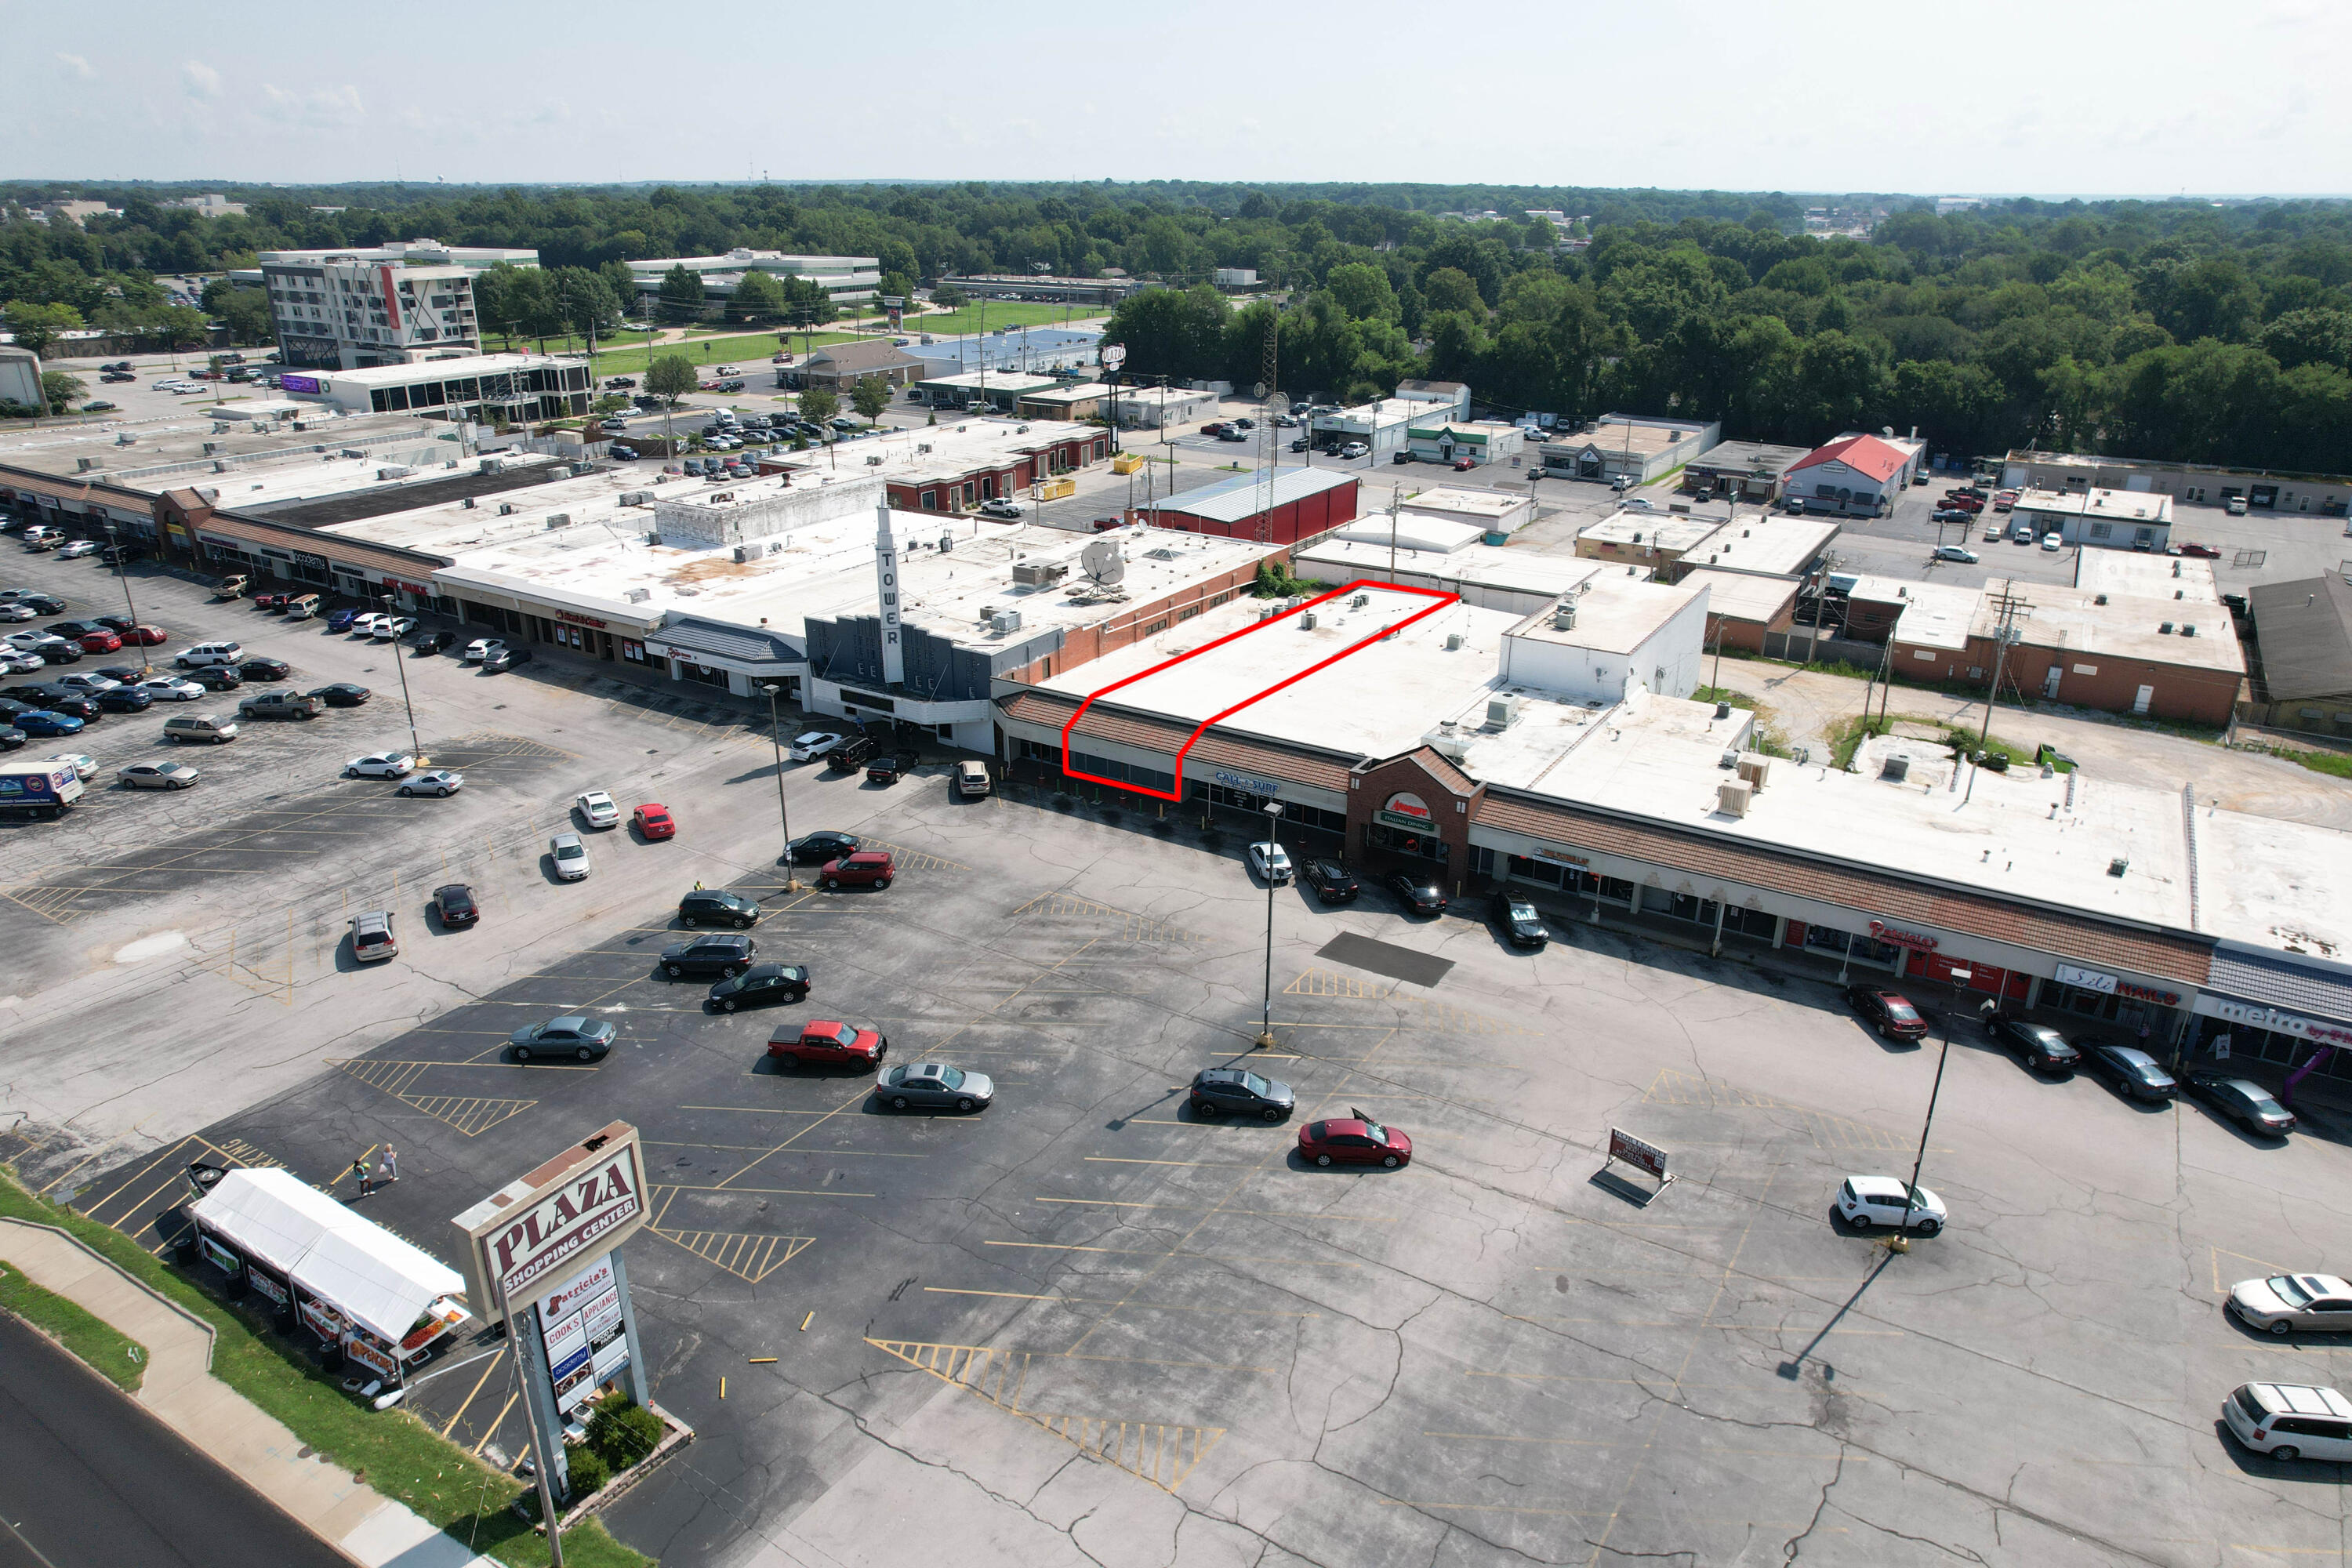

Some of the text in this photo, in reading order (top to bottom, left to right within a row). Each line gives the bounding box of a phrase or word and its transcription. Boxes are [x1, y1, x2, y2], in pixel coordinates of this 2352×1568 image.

[882, 553, 898, 644] TOWER
[1216, 771, 1241, 786] CALL
[1254, 779, 1280, 793] SURF
[1385, 815, 1429, 829] ITALIAN DINING
[1869, 920, 1939, 949] Patricia's
[2118, 982, 2180, 1006] NAILS
[2218, 1001, 2307, 1033] metro
[493, 1163, 632, 1276] PLAZA
[505, 1237, 579, 1290] SHOPPING
[583, 1200, 634, 1241] CENTER
[546, 1267, 608, 1317] Patricia's
[549, 1318, 579, 1344] COOK'S
[584, 1290, 618, 1320] APPLIANCE
[593, 1330, 609, 1345] GOOD
[609, 1323, 619, 1333] DAY
[601, 1332, 615, 1345] FARM
[556, 1351, 586, 1374] academy
